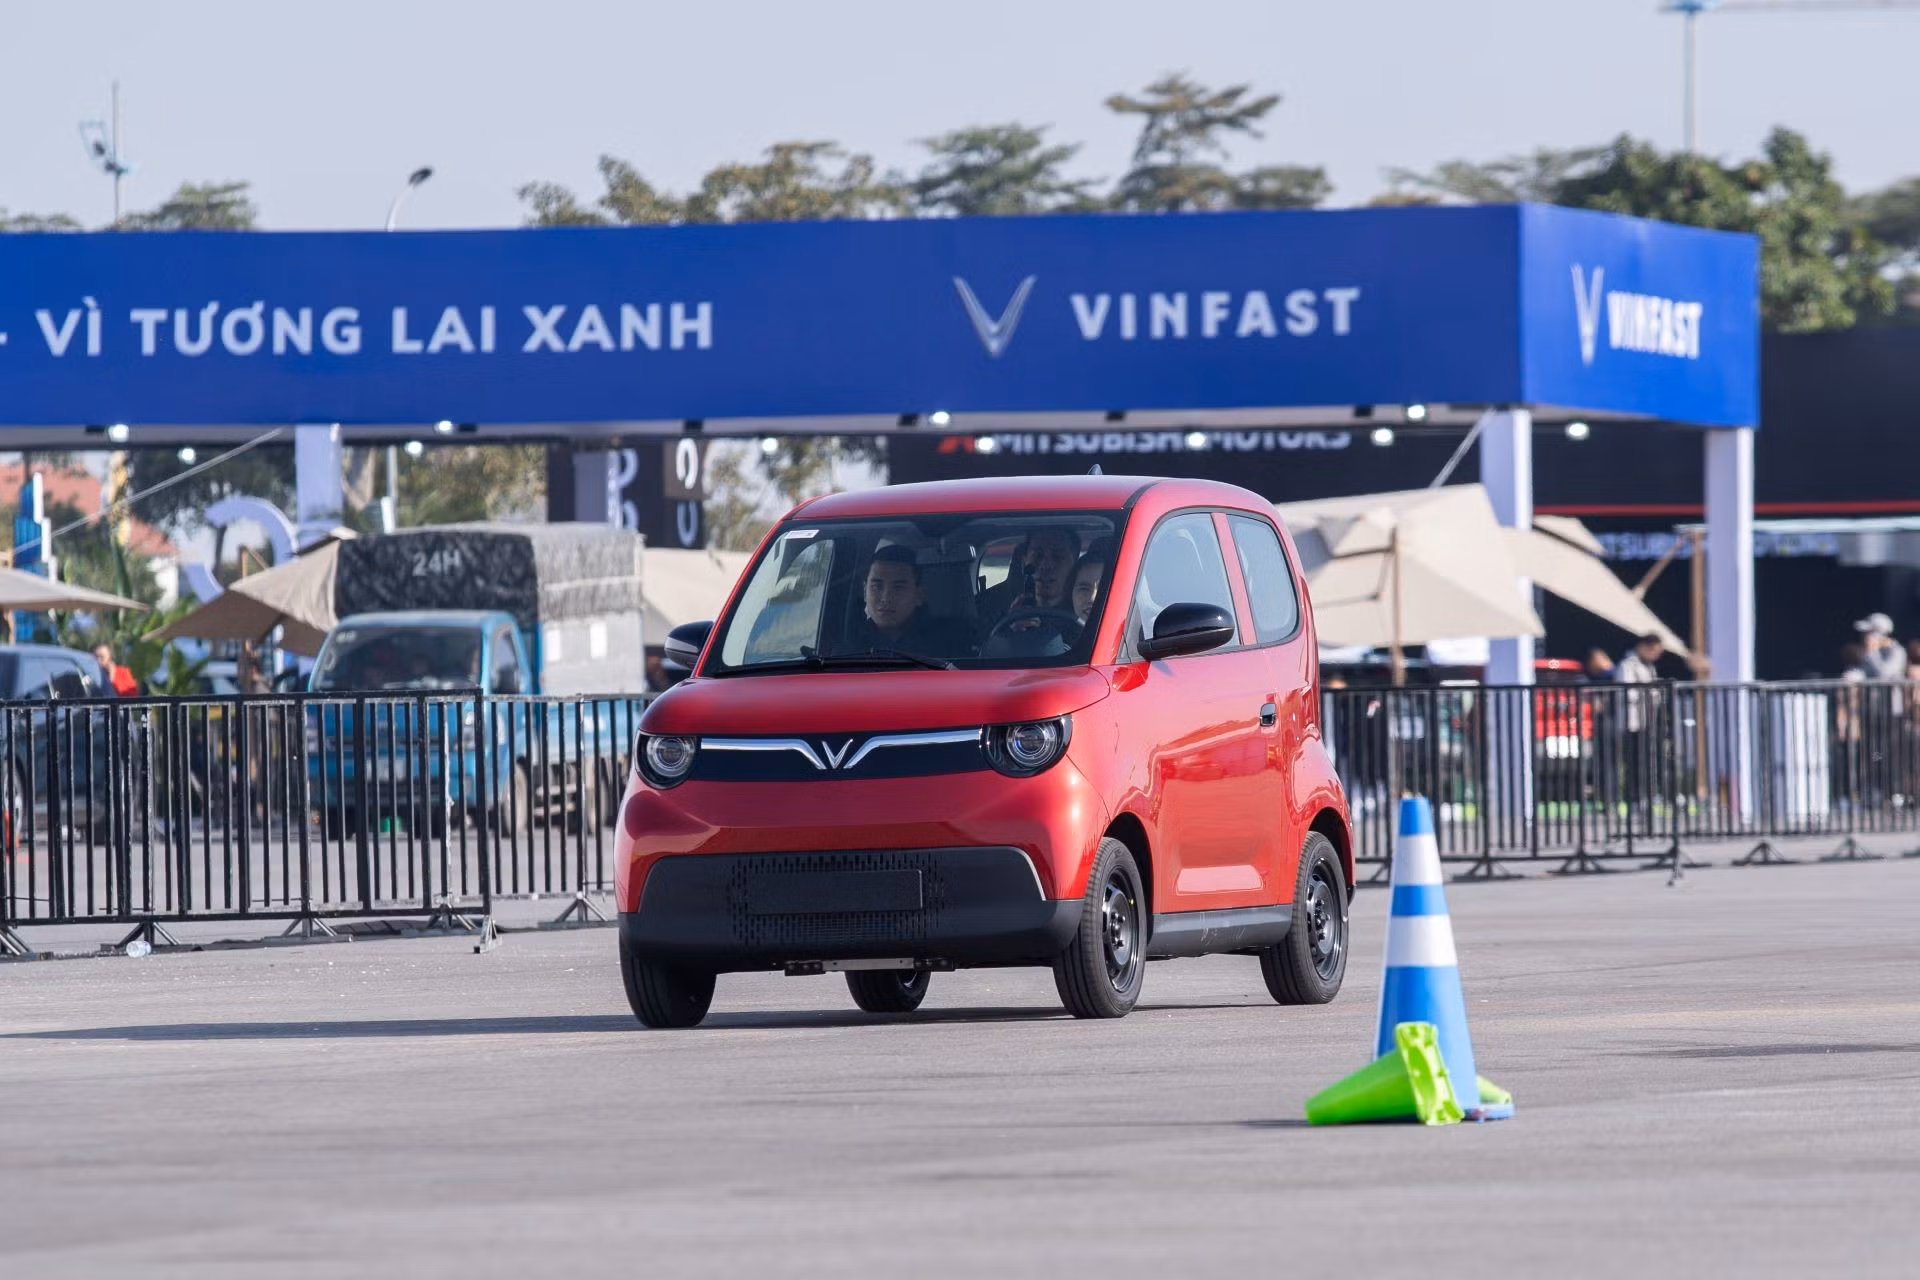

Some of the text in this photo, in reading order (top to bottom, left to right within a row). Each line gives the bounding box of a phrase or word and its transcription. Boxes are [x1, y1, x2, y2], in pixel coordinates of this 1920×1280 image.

[36, 297, 713, 357] VÌ TƯƠNG LAI XANH
[1070, 287, 1361, 340] VINFAST
[1606, 291, 1702, 358] VINFAST
[412, 549, 462, 577] 24H
